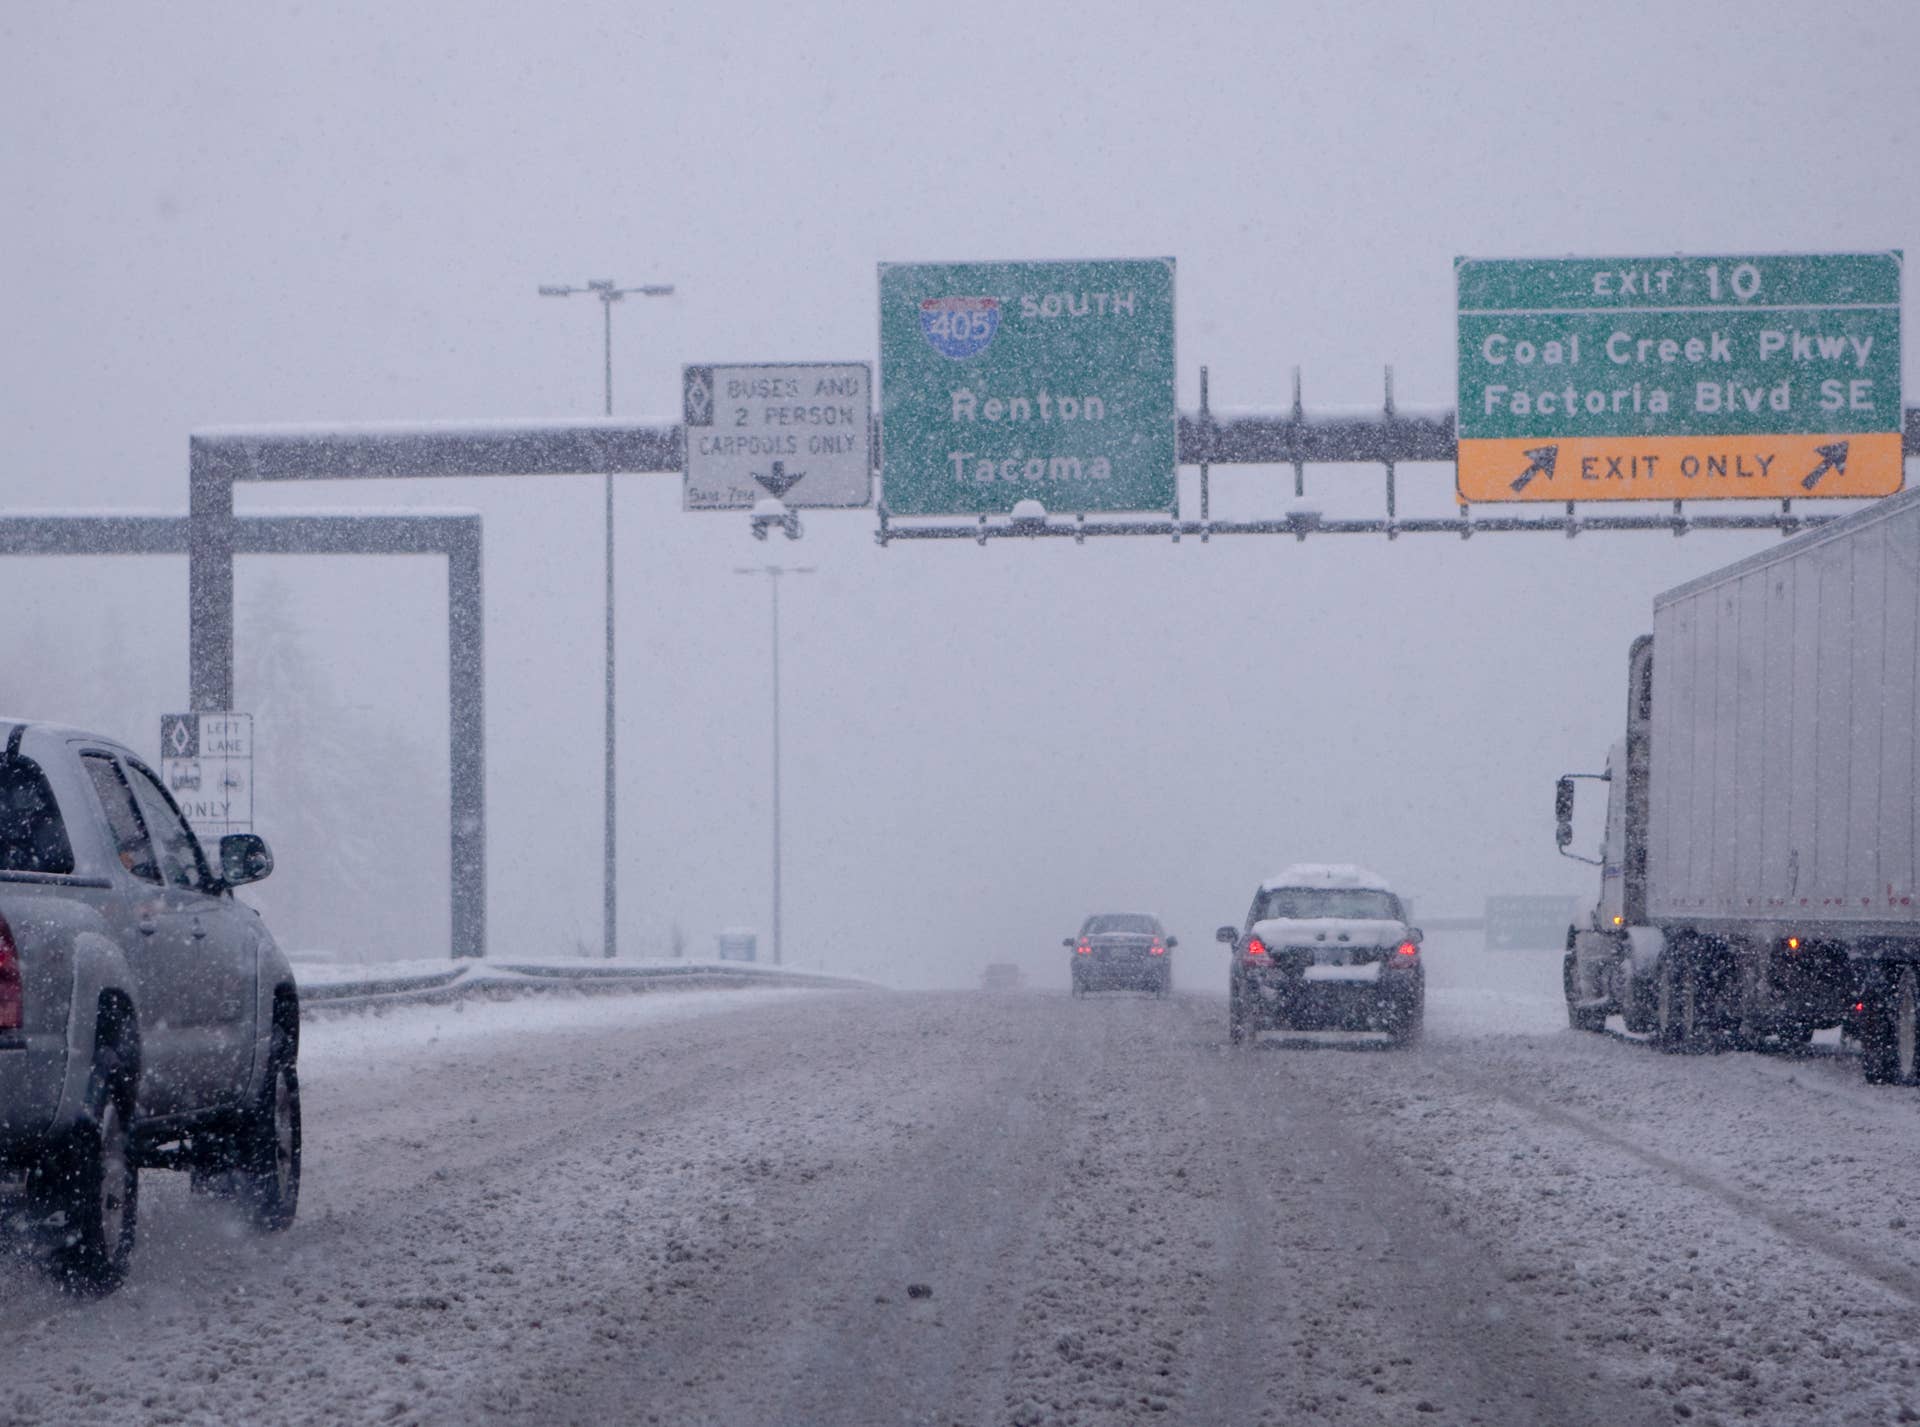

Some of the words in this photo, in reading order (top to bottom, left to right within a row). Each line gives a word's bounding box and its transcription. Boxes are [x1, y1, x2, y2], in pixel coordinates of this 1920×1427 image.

[1594, 269, 1674, 296] EXIT
[1706, 264, 1761, 299] 10
[1019, 291, 1135, 318] SOUTH
[931, 311, 991, 341] 405
[1482, 334, 1580, 366] Coal
[1605, 331, 1732, 364] Creek
[1759, 330, 1874, 368] Pkwy
[727, 379, 799, 399] BUSES
[815, 378, 859, 397] AND
[1484, 383, 1670, 418] Factoria
[1695, 380, 1791, 414] Blvd
[1819, 379, 1875, 410] SE
[735, 407, 749, 426] 2
[765, 406, 854, 426] PERSON
[951, 387, 1105, 422] Renton
[699, 434, 797, 456] CARPOOLS
[808, 433, 856, 455] ONLY
[948, 450, 1111, 483] Tacoma
[1581, 455, 1659, 481] EXIT
[1680, 453, 1775, 479] ONLY
[207, 740, 241, 753] LANE
[182, 801, 231, 818] ONLY
